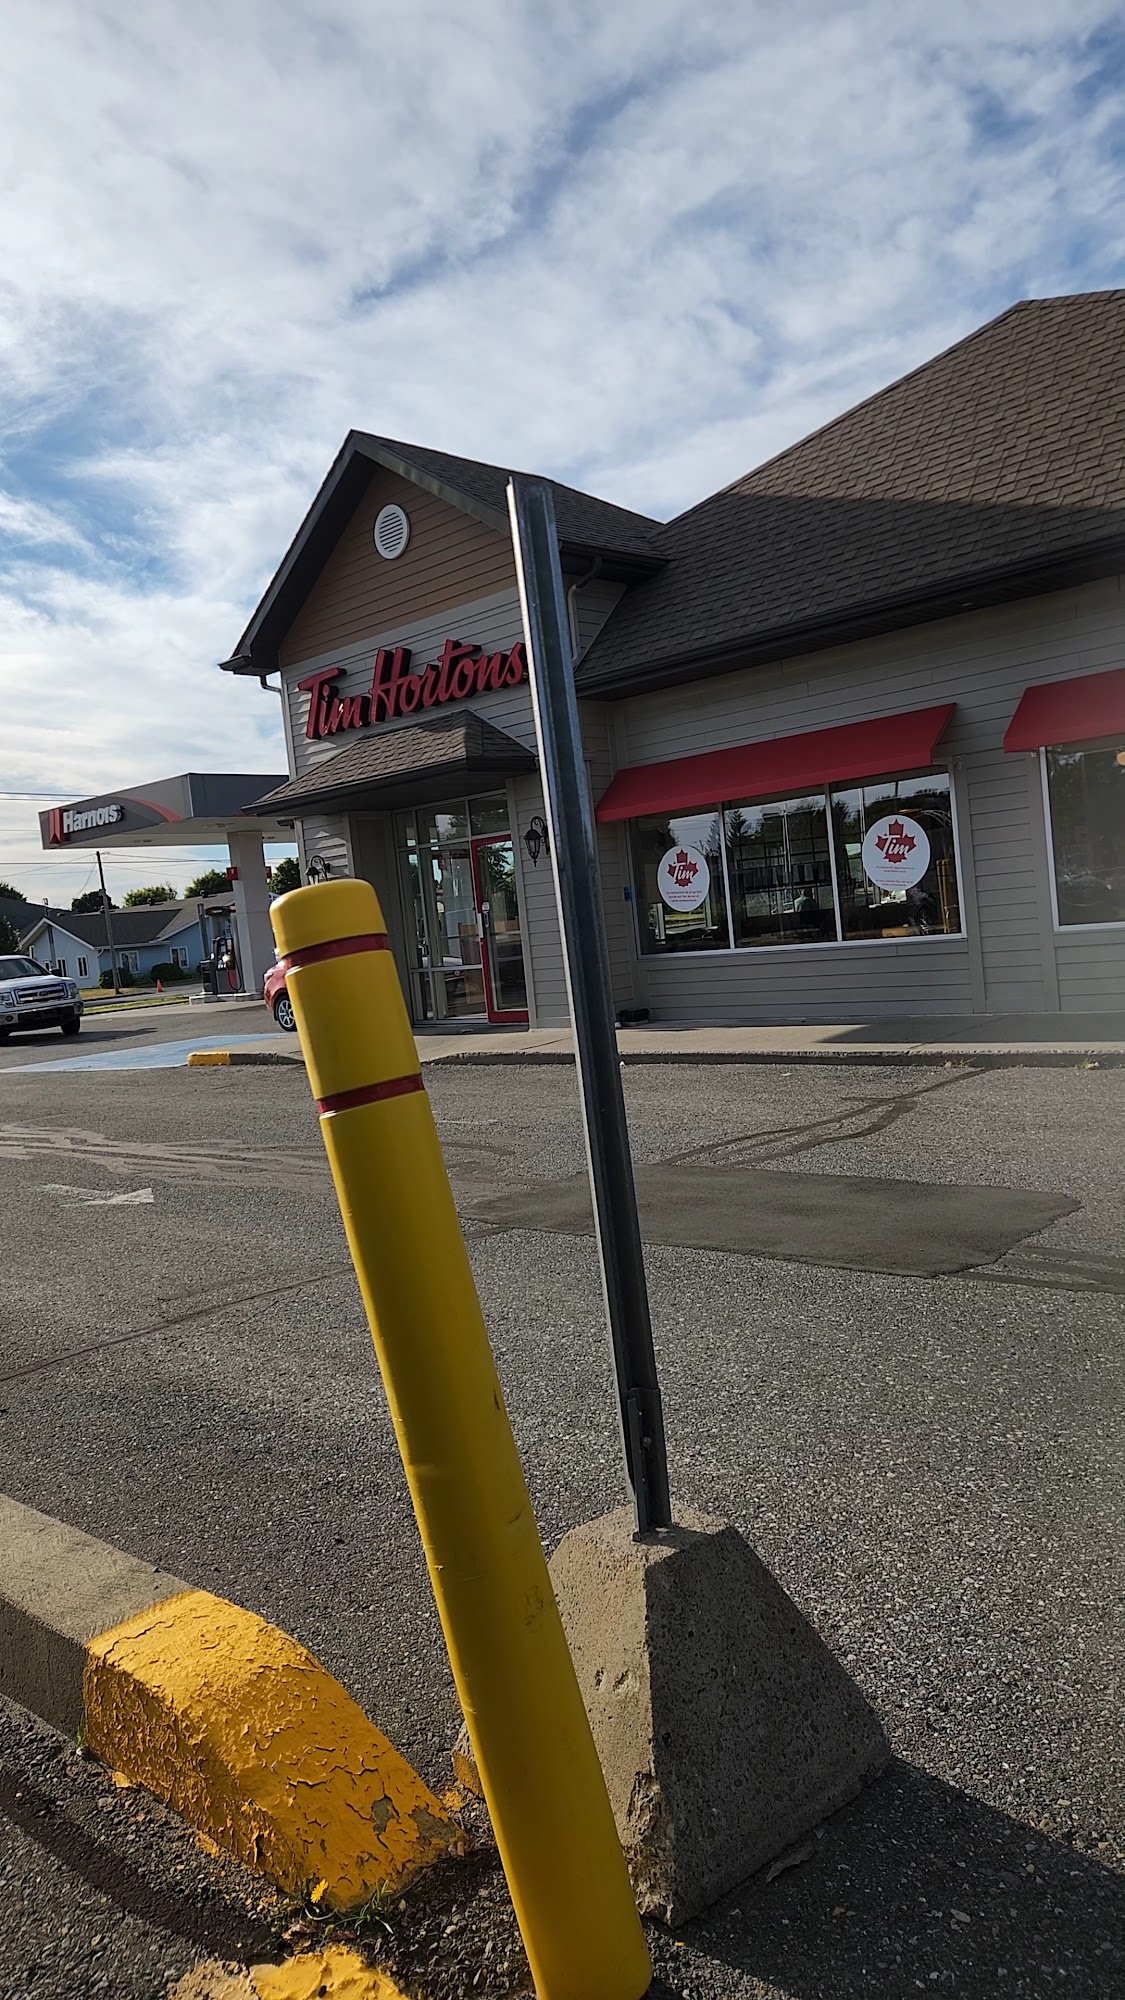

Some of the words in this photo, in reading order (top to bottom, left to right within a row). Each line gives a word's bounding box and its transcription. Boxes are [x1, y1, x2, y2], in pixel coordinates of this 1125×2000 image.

[298, 667, 371, 740] Tim
[369, 639, 528, 722] Hortons
[63, 804, 122, 834] Harnois
[882, 834, 909, 855] Tim
[671, 862, 694, 881] Tim
